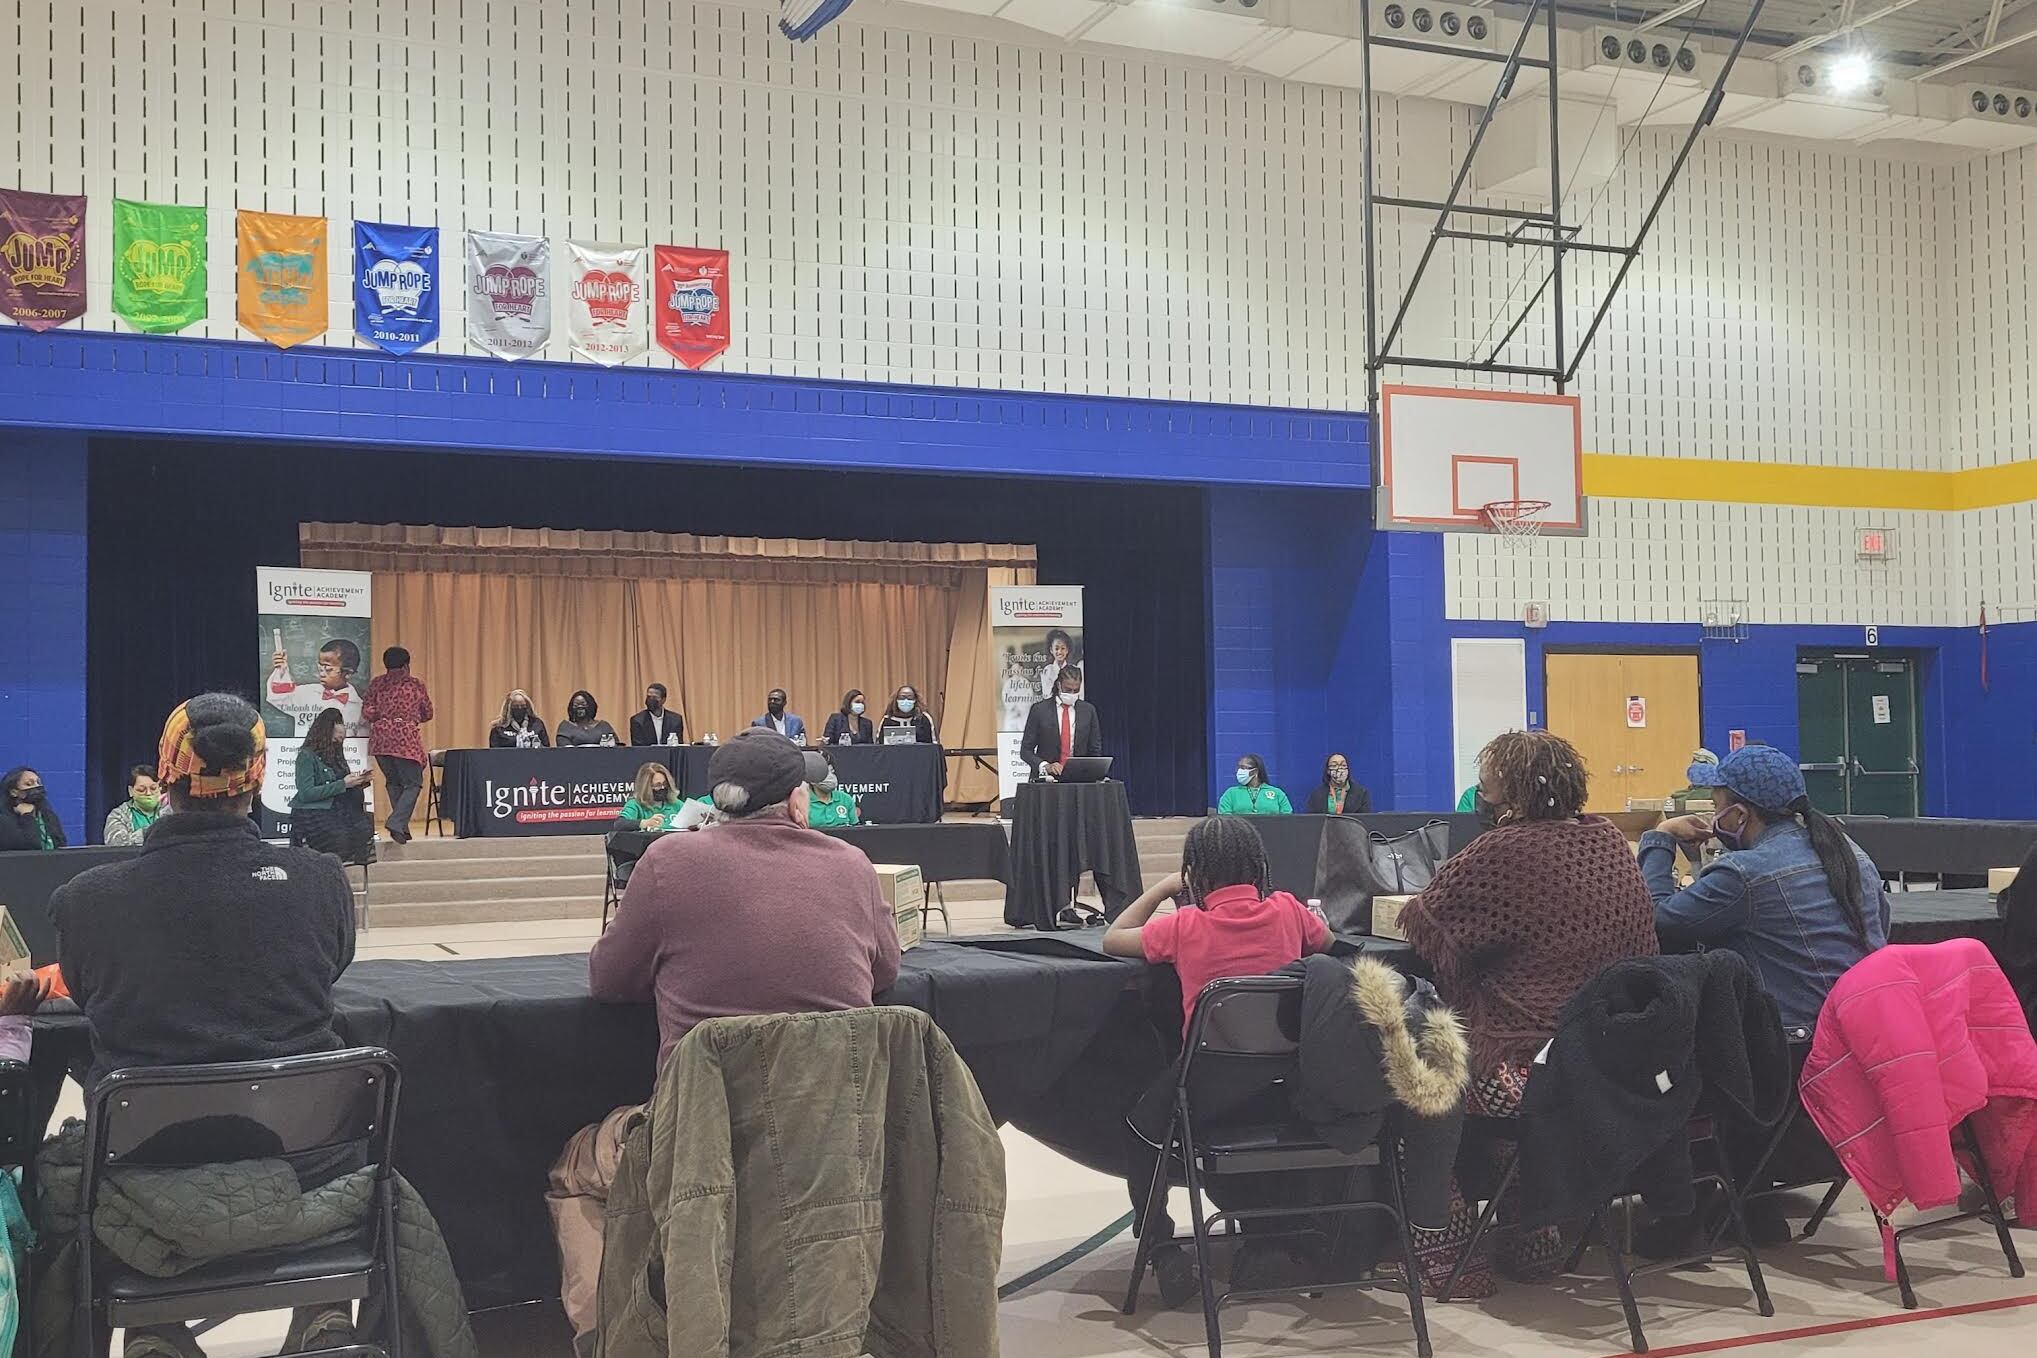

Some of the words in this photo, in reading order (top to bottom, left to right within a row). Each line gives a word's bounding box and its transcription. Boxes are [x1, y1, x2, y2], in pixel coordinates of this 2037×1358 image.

[10, 238, 67, 274] JUMP
[363, 269, 398, 290] JUMP
[399, 271, 431, 292] ROPE
[474, 274, 510, 297] JUMP
[510, 276, 545, 299] ROPE
[572, 281, 607, 302] JUMP
[608, 282, 640, 303] ROPE
[669, 293, 695, 311] JUMP
[695, 294, 720, 312] ROPE
[12, 306, 67, 319] 2006-2007
[373, 330, 420, 342] 2010-2011
[487, 338, 533, 348] 2011-2012
[585, 343, 629, 353] 2012-2013
[269, 581, 312, 602] Ignite
[316, 586, 364, 594] ACHIEVEMENT
[1000, 597, 1036, 616] Ignite
[1867, 628, 1877, 644] 6
[277, 758, 296, 768] Proje
[834, 783, 889, 793] EVEMENT
[485, 777, 566, 818] Ignite
[573, 782, 635, 793] ACHIEVEM
[573, 792, 630, 804] ACADEMY
[520, 811, 547, 821] igniting
[560, 811, 585, 819] passion
[586, 809, 596, 818] for
[596, 807, 622, 817] learnin
[252, 870, 275, 878] NORTH
